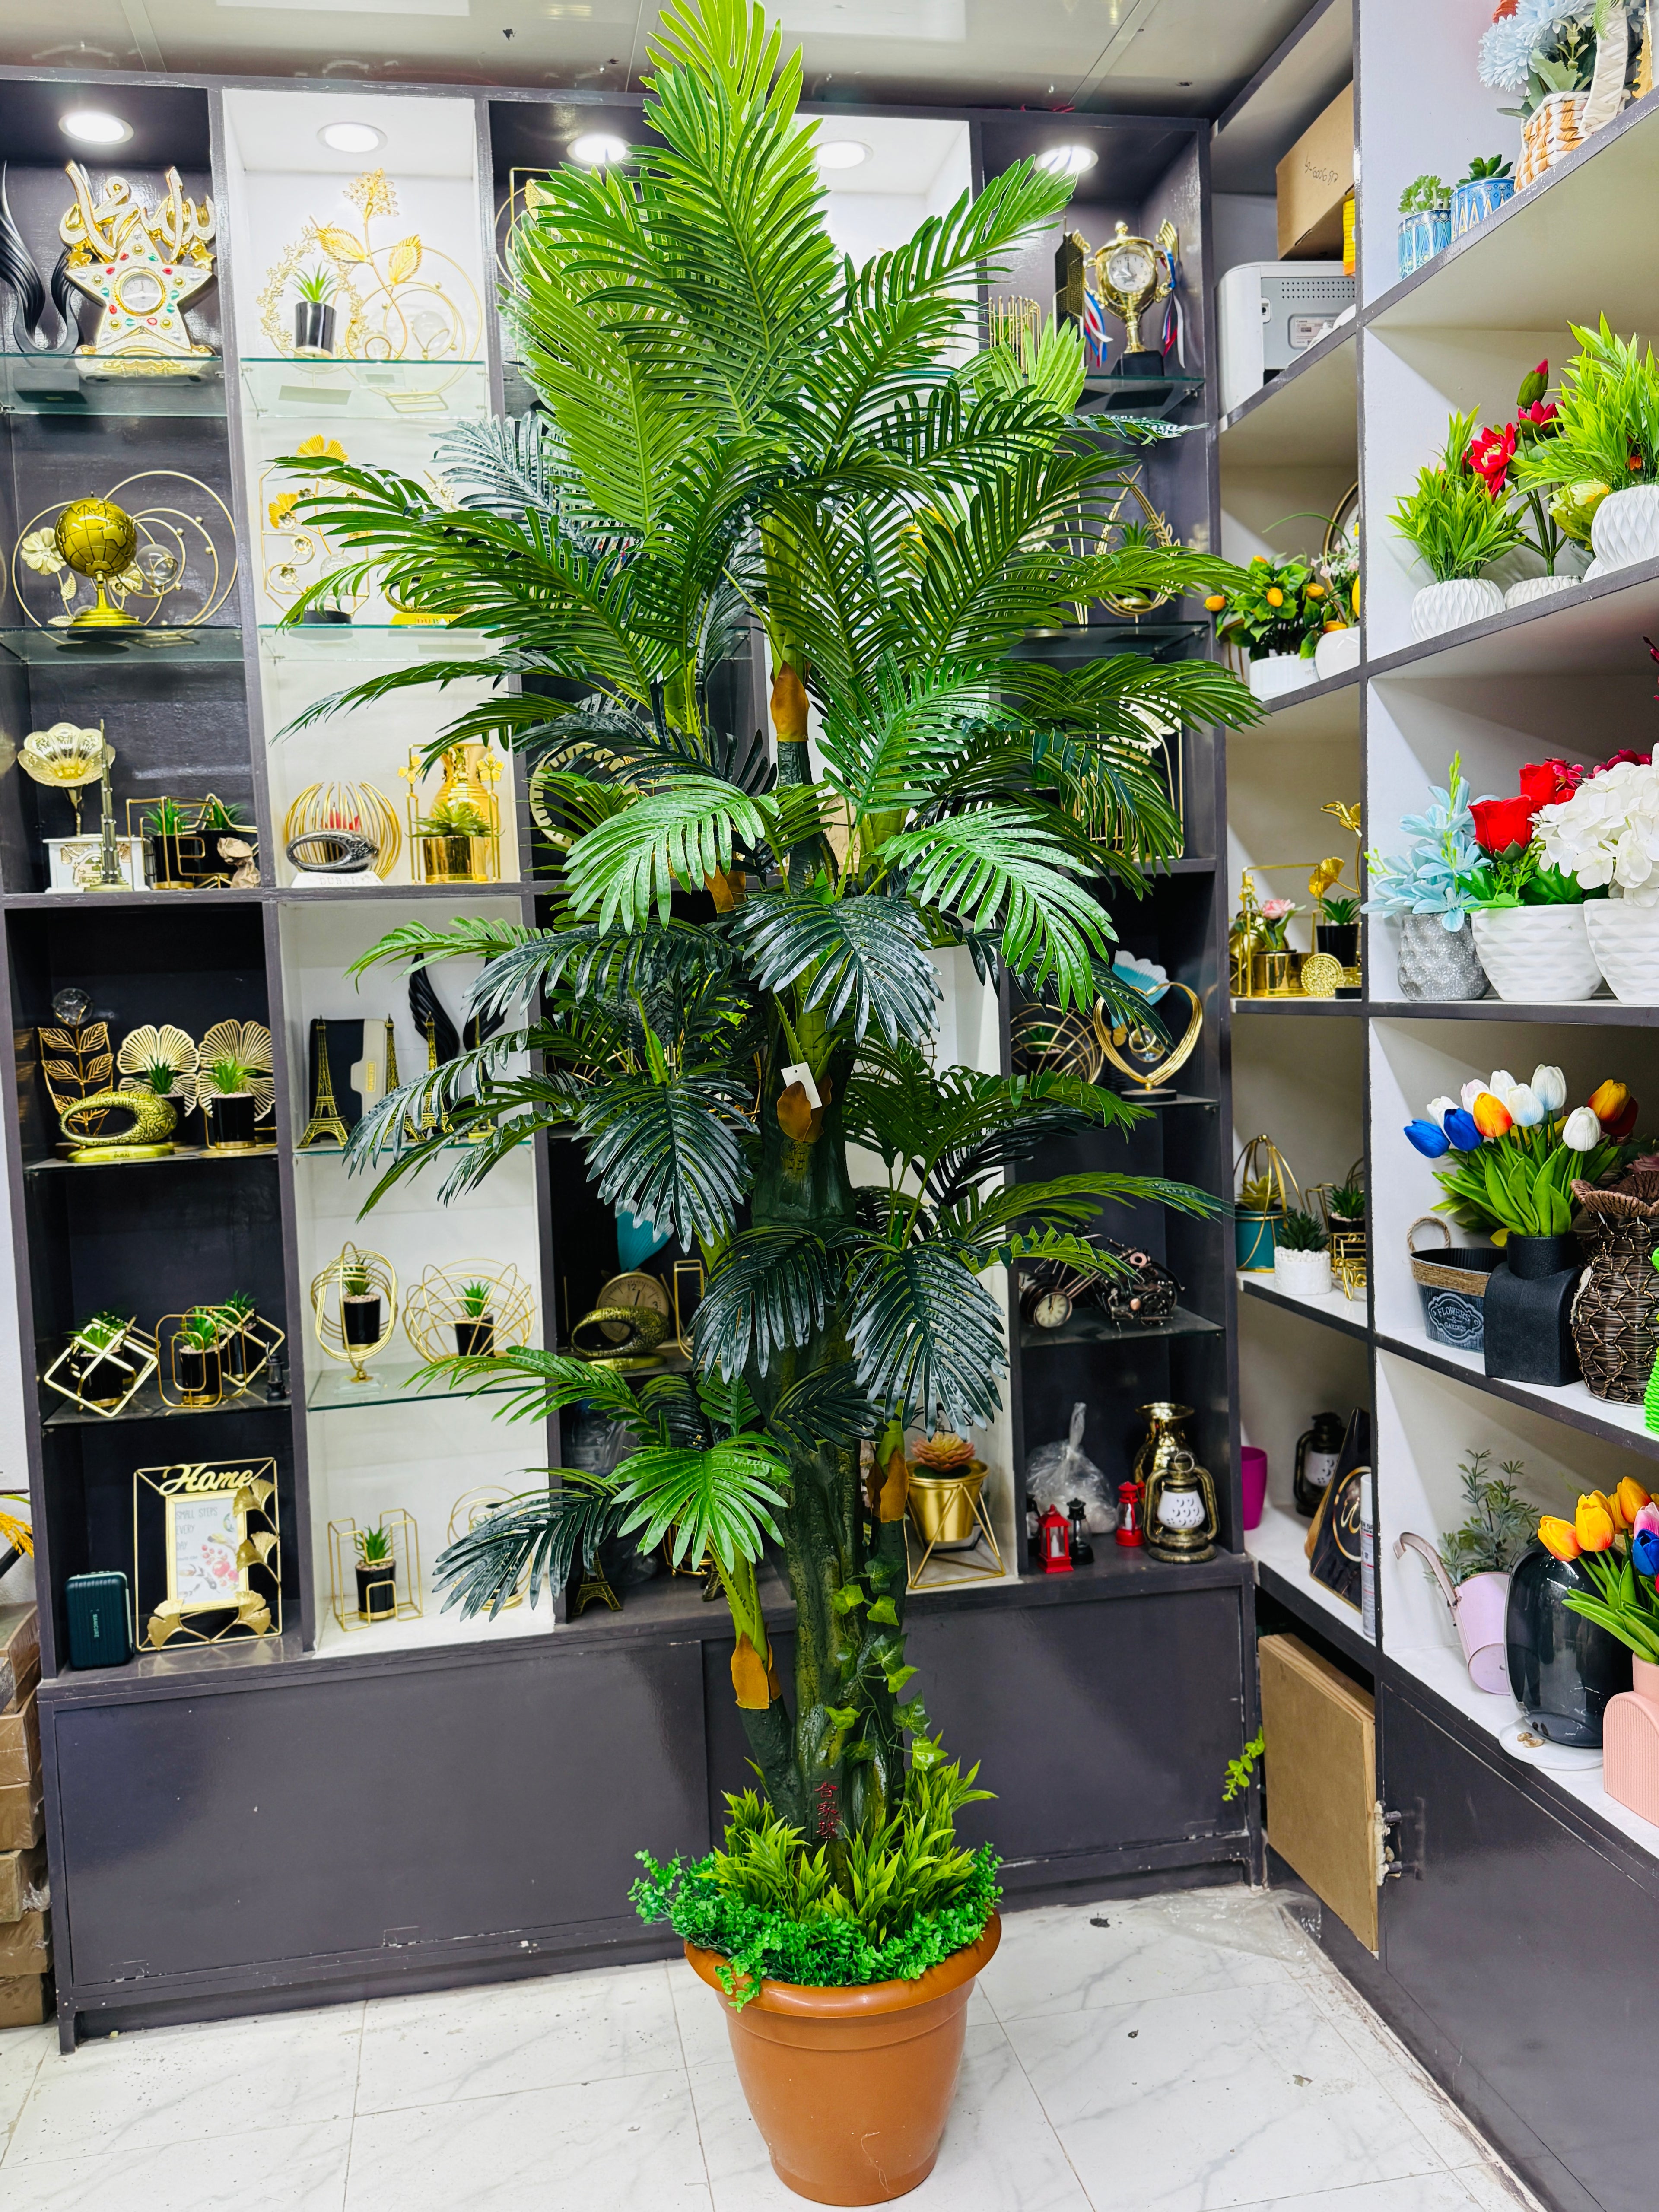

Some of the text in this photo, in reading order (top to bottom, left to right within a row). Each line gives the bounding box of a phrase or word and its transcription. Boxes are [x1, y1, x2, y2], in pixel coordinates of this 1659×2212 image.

[853, 843, 858, 852] 6
[320, 877, 356, 885] DUBAI
[652, 1300, 659, 1310] 3
[1437, 1306, 1471, 1322] FLOWERS
[159, 1463, 254, 1495] Home
[175, 1506, 218, 1519] SMALL STEPS
[175, 1524, 195, 1535] EVERY
[176, 1541, 188, 1551] DAY
